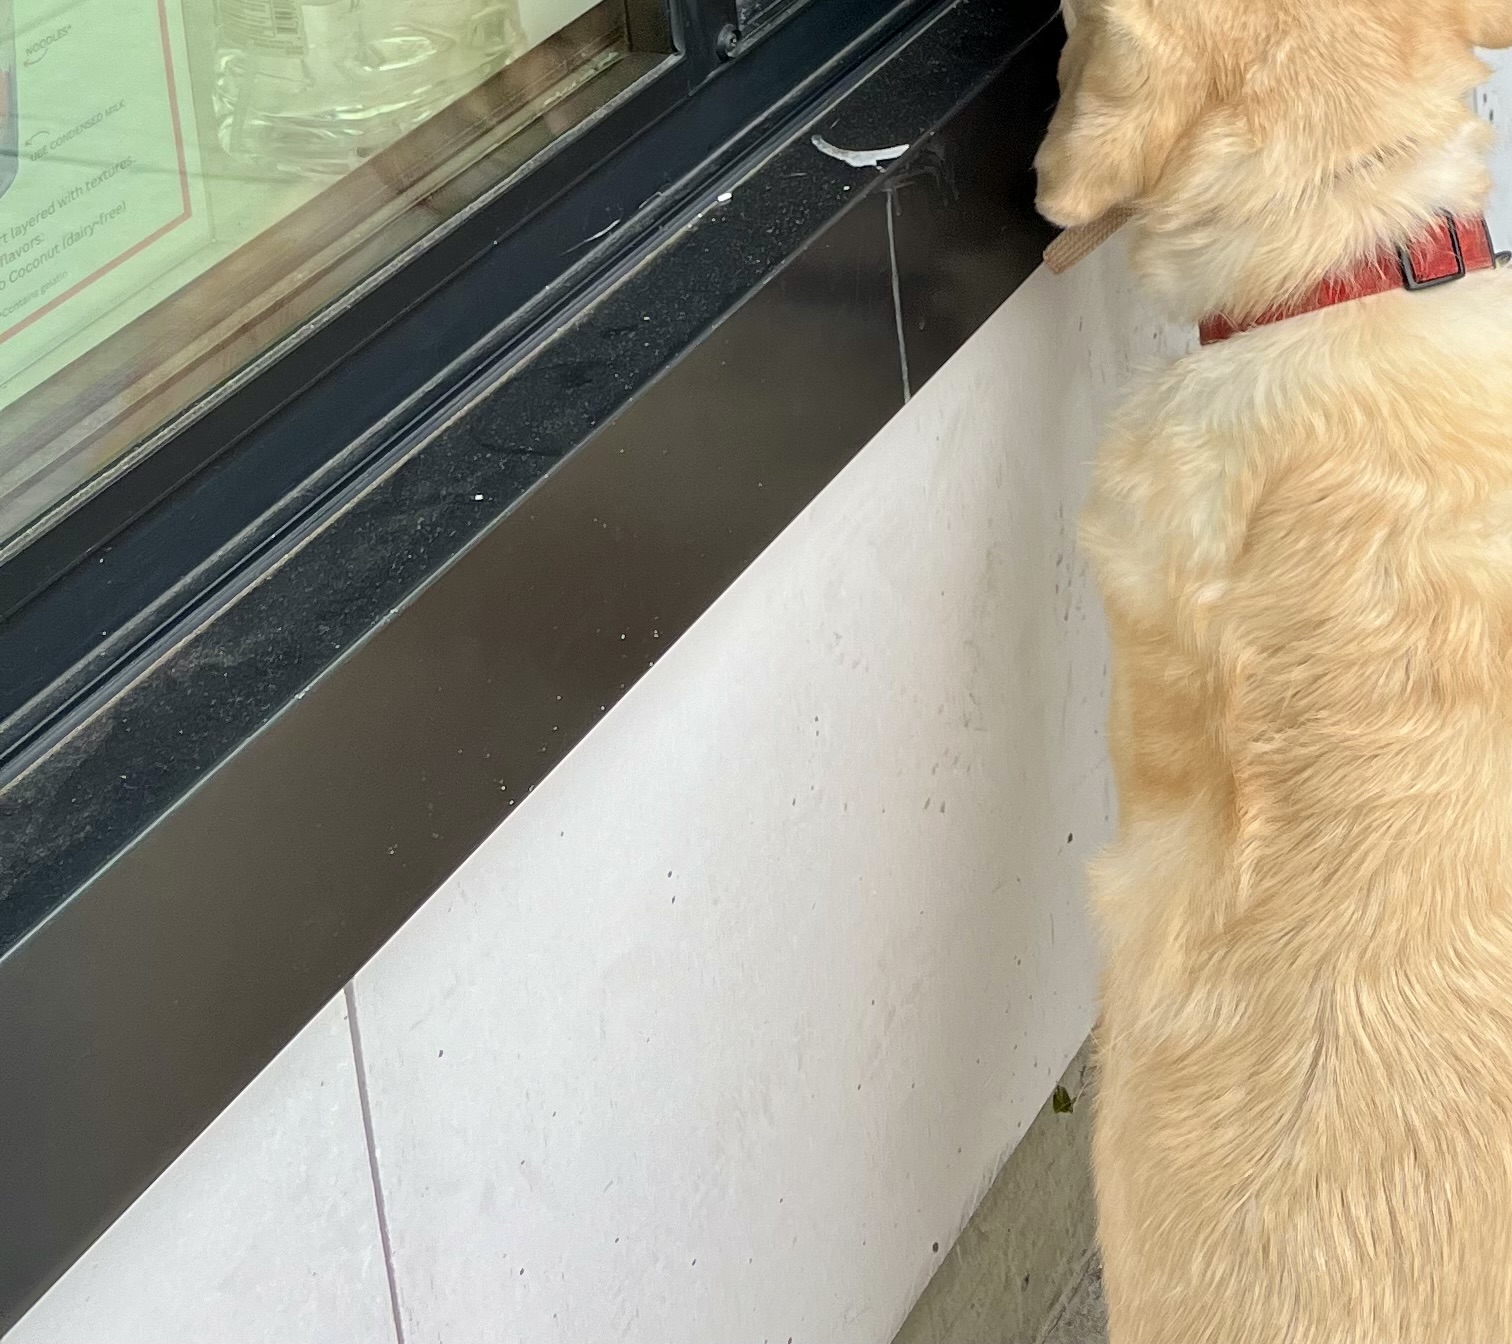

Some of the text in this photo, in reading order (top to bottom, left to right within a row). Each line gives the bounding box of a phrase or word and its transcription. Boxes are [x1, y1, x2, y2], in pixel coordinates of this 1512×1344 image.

[10, 200, 56, 240] layered
[56, 185, 84, 209] with
[8, 242, 61, 285] Coconut
